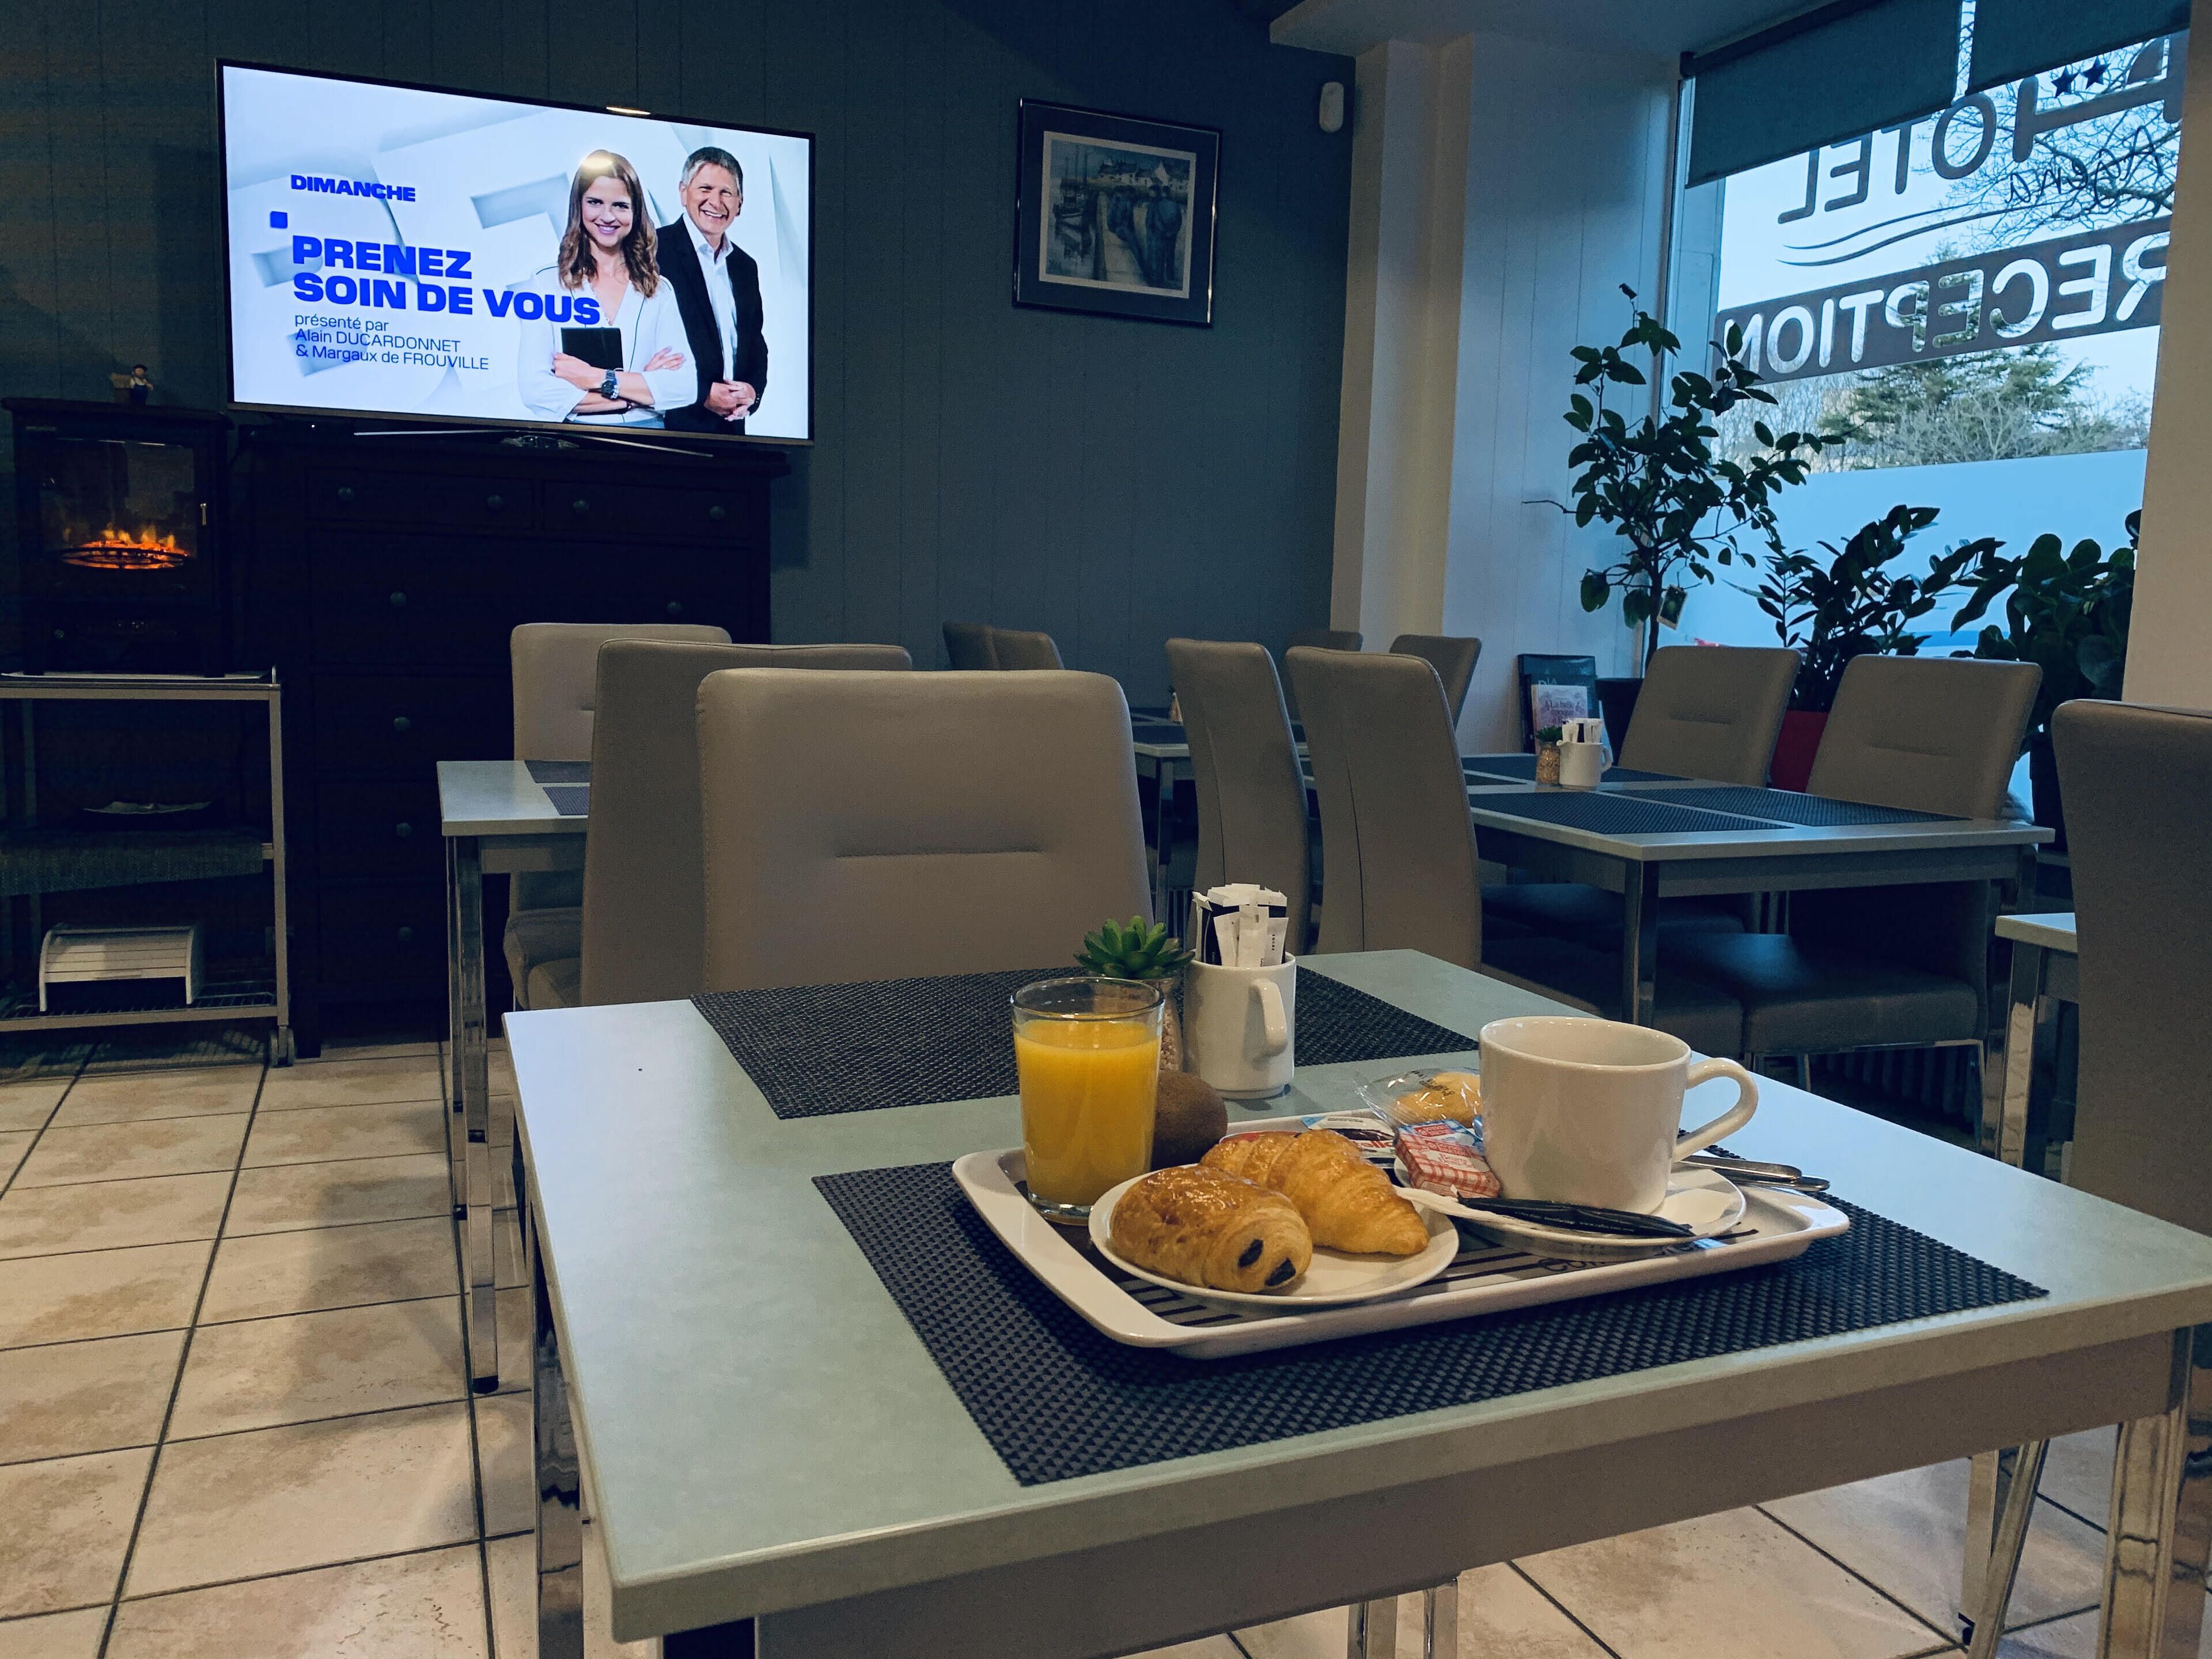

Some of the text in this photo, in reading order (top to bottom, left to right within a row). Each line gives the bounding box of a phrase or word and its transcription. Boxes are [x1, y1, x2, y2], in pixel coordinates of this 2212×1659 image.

[291, 175, 415, 202] DIMANCHE
[293, 235, 472, 279] PRENEZ
[294, 272, 600, 325] SOIN DE VOUS
[295, 314, 389, 332] présenté par
[296, 328, 461, 353] Alain DUCARDONNET
[296, 344, 489, 370] & Margaux de FROUVILLE
